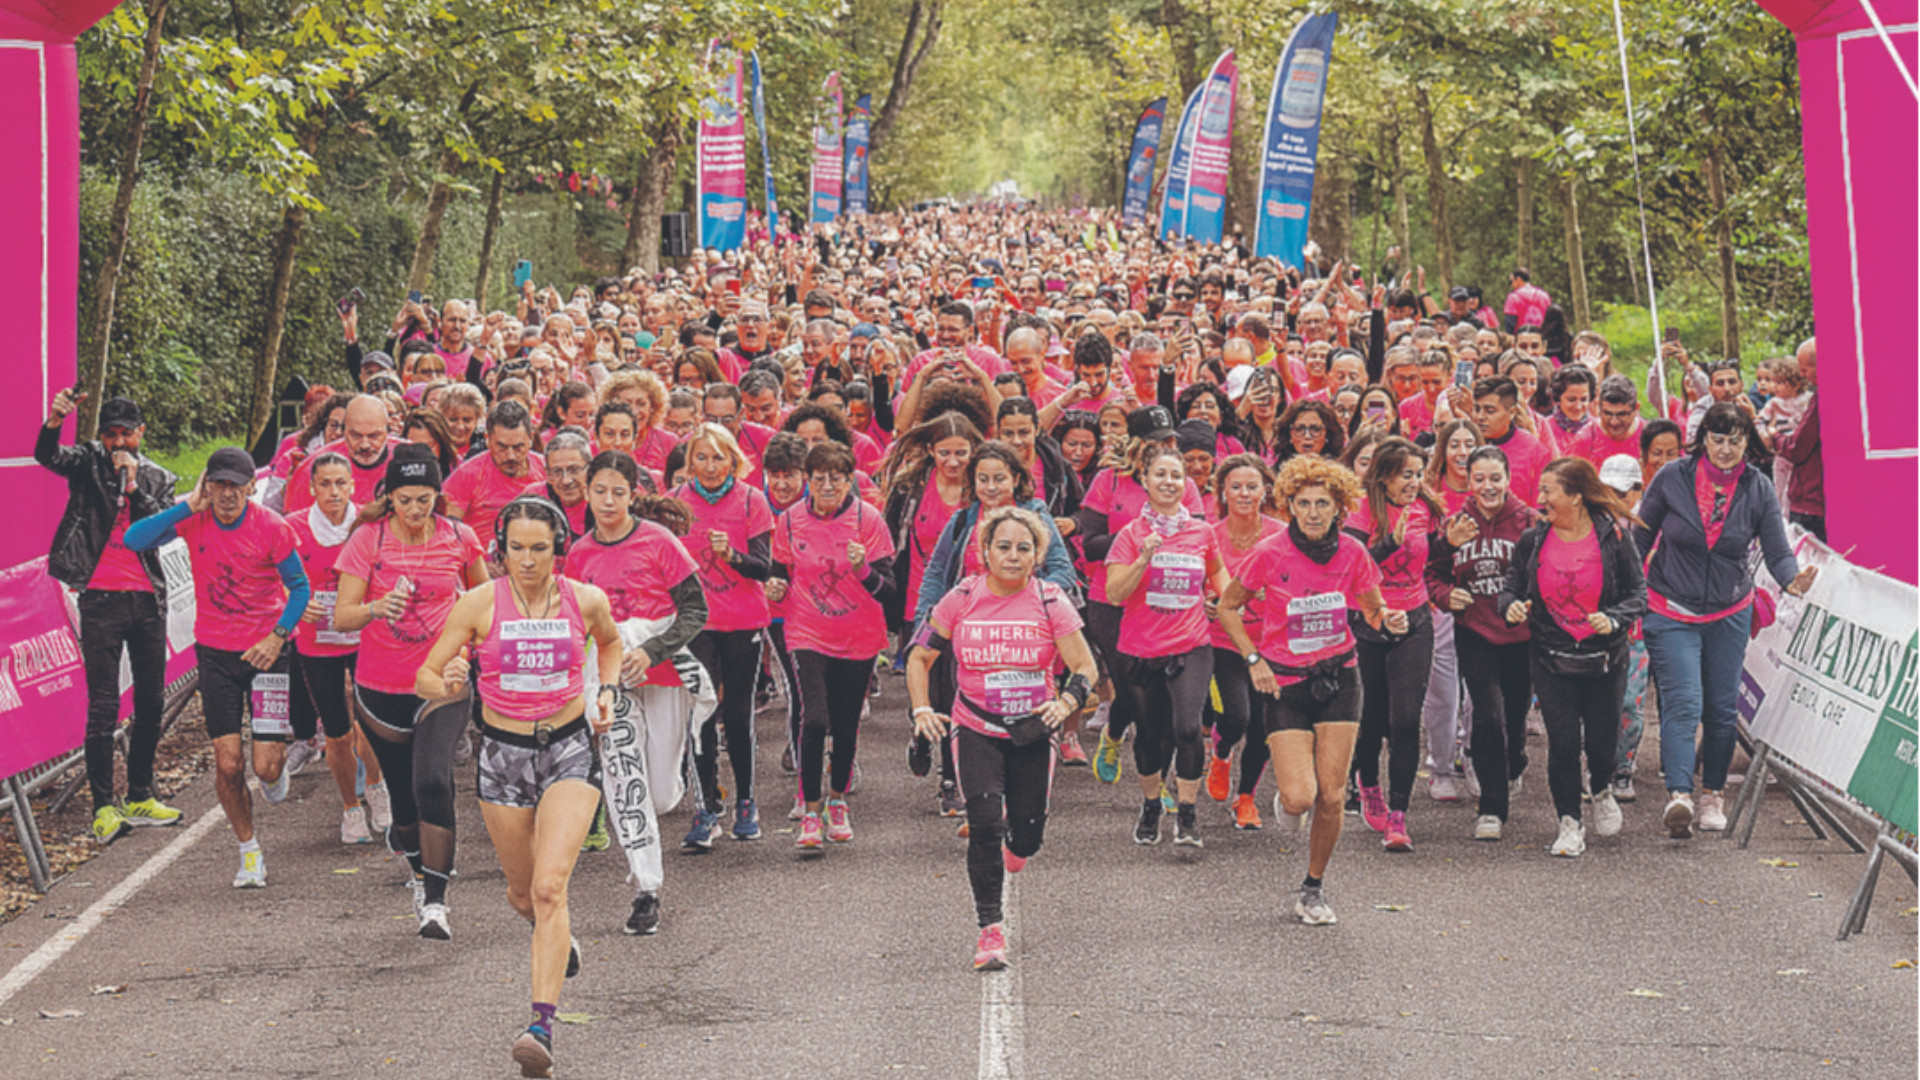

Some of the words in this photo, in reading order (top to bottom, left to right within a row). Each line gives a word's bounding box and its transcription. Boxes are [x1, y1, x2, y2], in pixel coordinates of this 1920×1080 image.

[1162, 577, 1190, 591] 2024
[961, 626, 982, 641] I'M
[1302, 620, 1333, 633] 2024
[10, 625, 79, 681] HUMANITAS
[1786, 602, 1901, 700] HUMANITAS
[517, 652, 554, 669] 2024
[1001, 700, 1032, 713] 2024
